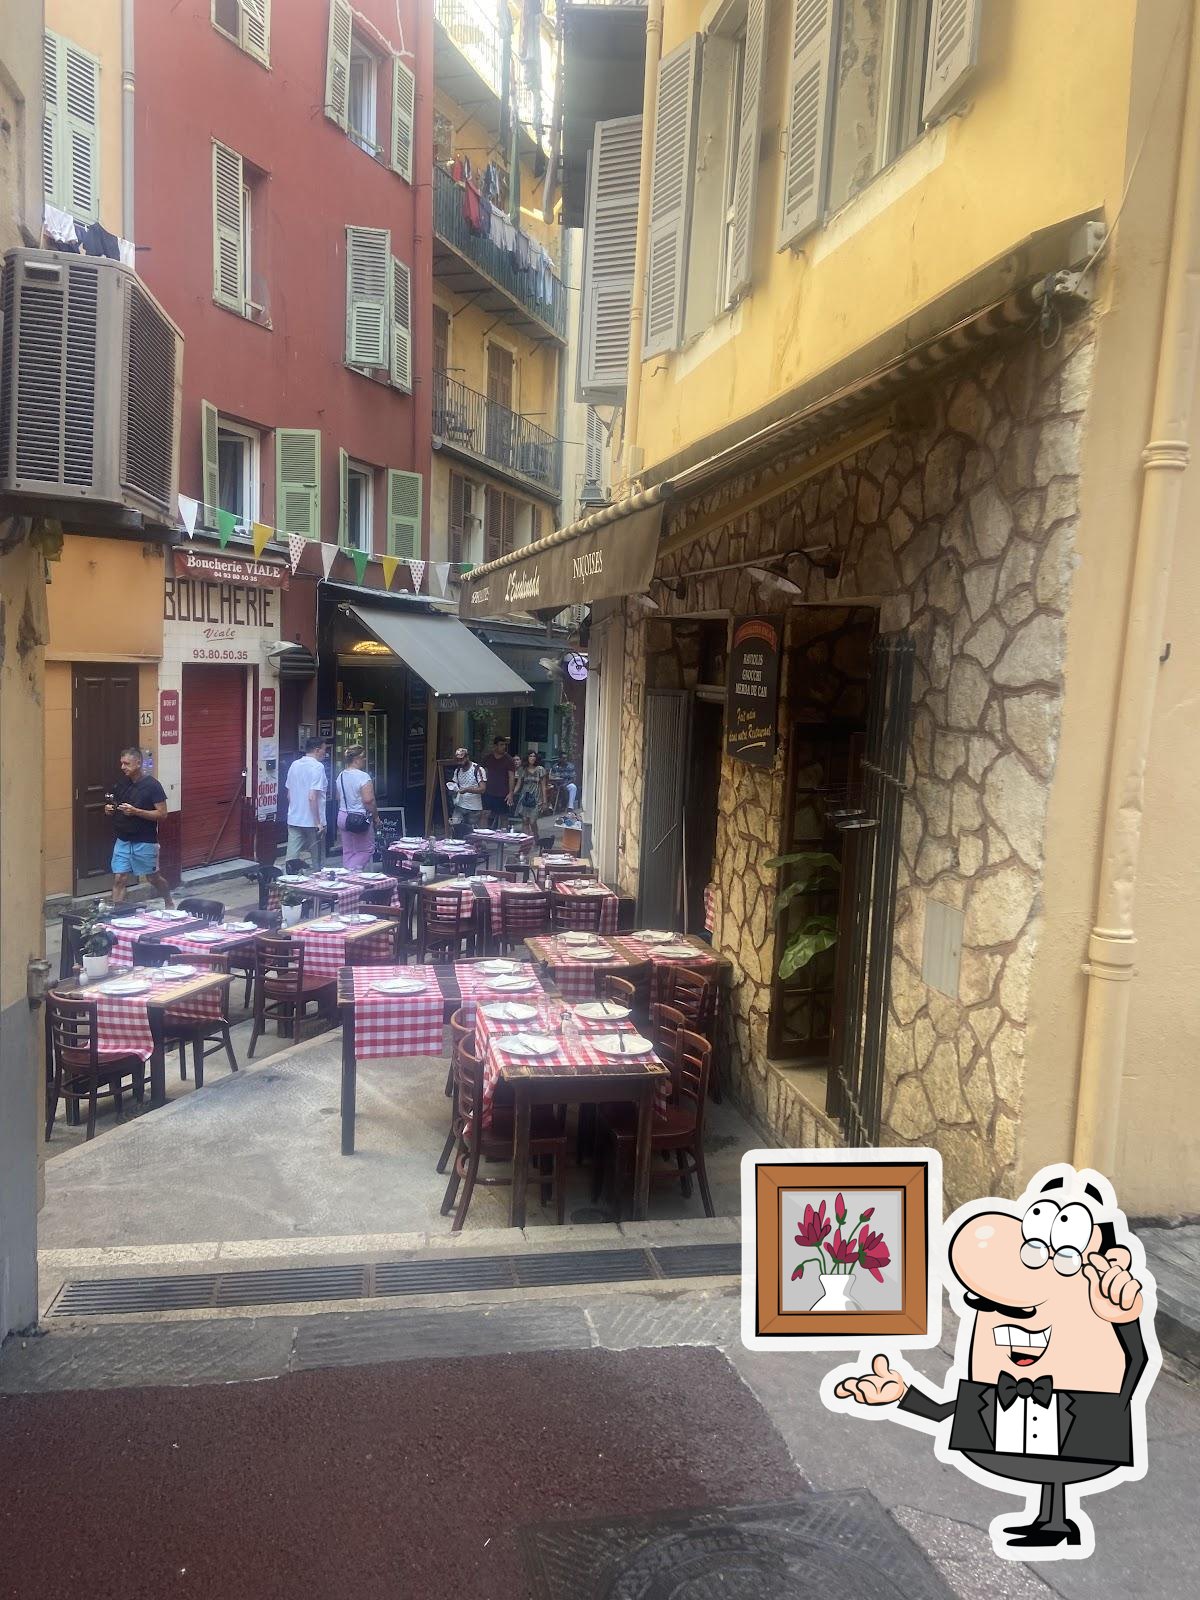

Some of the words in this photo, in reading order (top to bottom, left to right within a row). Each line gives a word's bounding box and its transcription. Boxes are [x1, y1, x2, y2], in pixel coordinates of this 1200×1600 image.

[187, 556, 242, 573] Boucherie
[246, 563, 281, 578] VIALE
[164, 577, 273, 627] BOUCHERIE
[203, 628, 236, 641] Viale
[193, 649, 248, 660] 93.80.50.35
[742, 669, 761, 681] GNOCCHI
[751, 685, 757, 697] DE
[758, 686, 767, 698] CAN
[141, 713, 151, 725] 15
